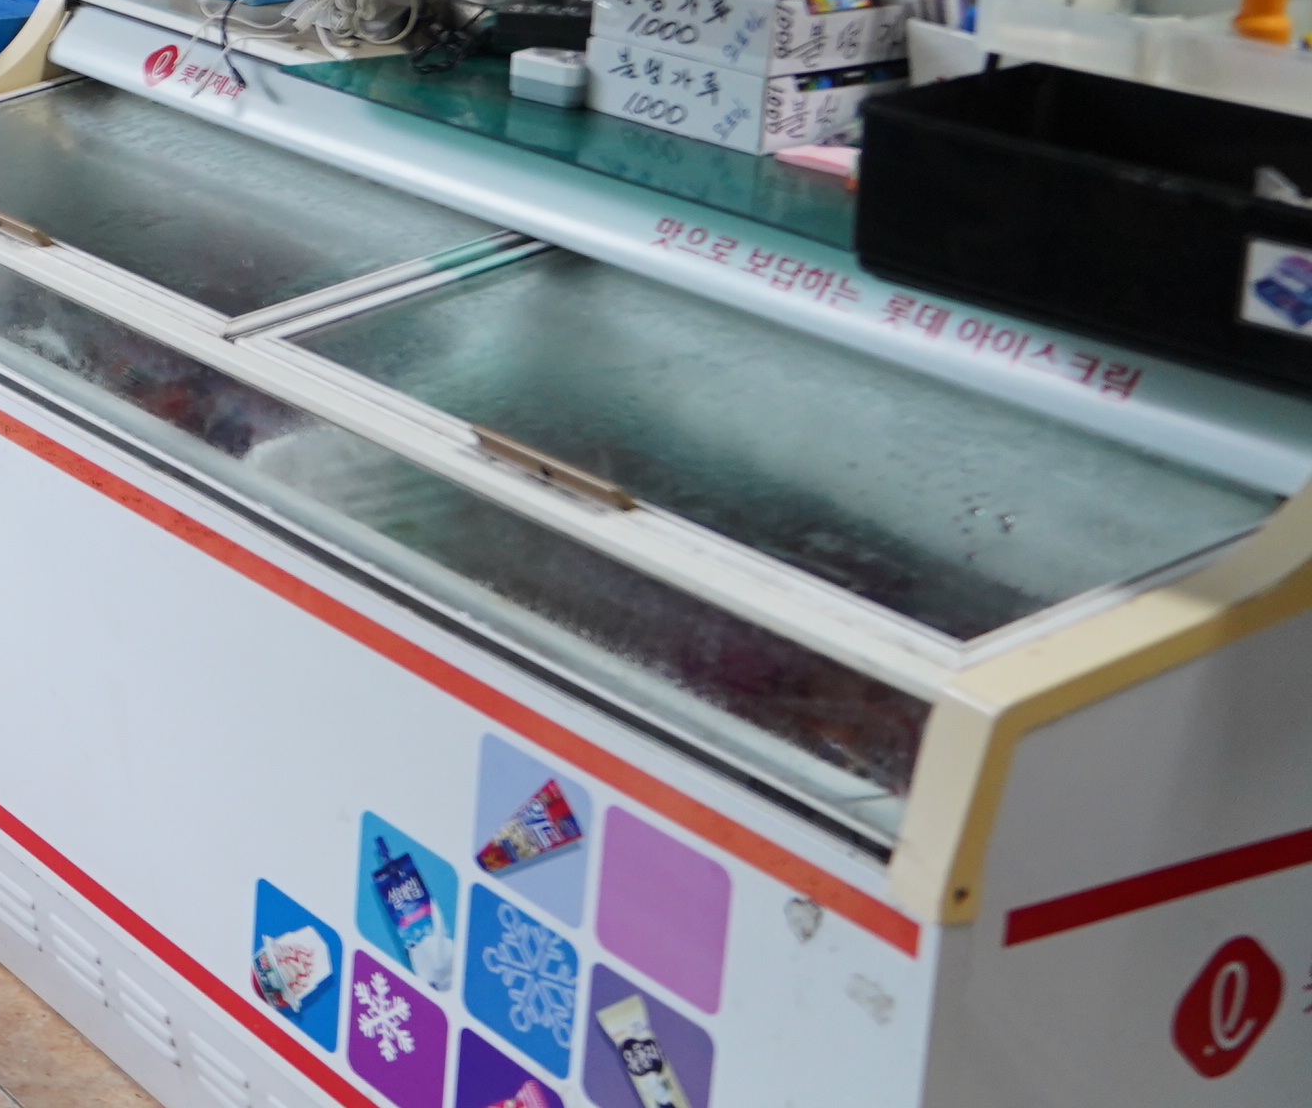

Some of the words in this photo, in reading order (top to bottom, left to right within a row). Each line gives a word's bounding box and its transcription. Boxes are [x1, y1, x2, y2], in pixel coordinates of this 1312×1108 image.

[623, 92, 687, 125] 1000
[652, 215, 739, 266] 맛으로
[746, 247, 862, 313] 보답하는
[879, 292, 952, 340] 롯데
[956, 316, 1145, 403] 아이스크림
